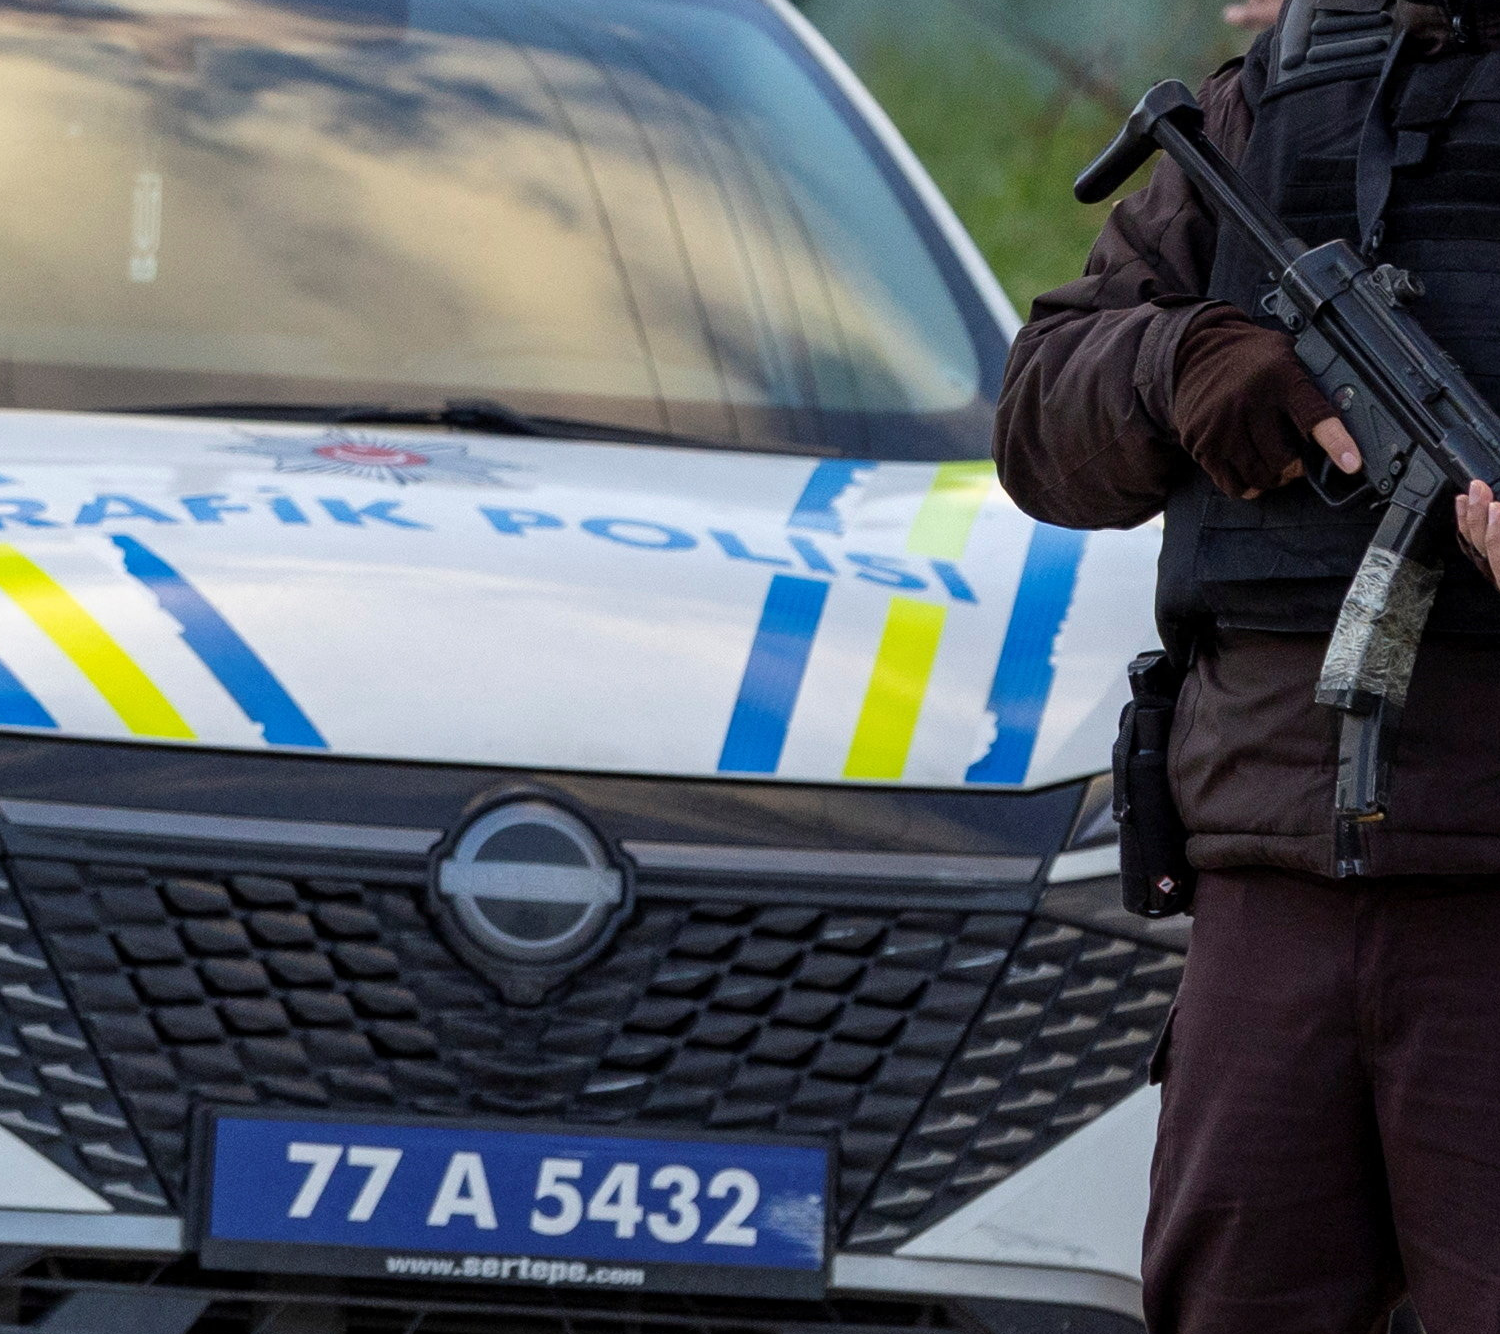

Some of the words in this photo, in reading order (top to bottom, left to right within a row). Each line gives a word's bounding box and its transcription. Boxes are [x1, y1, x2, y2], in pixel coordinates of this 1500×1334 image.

[287, 1141, 403, 1222] 77
[426, 1151, 499, 1230] A
[529, 1157, 760, 1247] 5432
